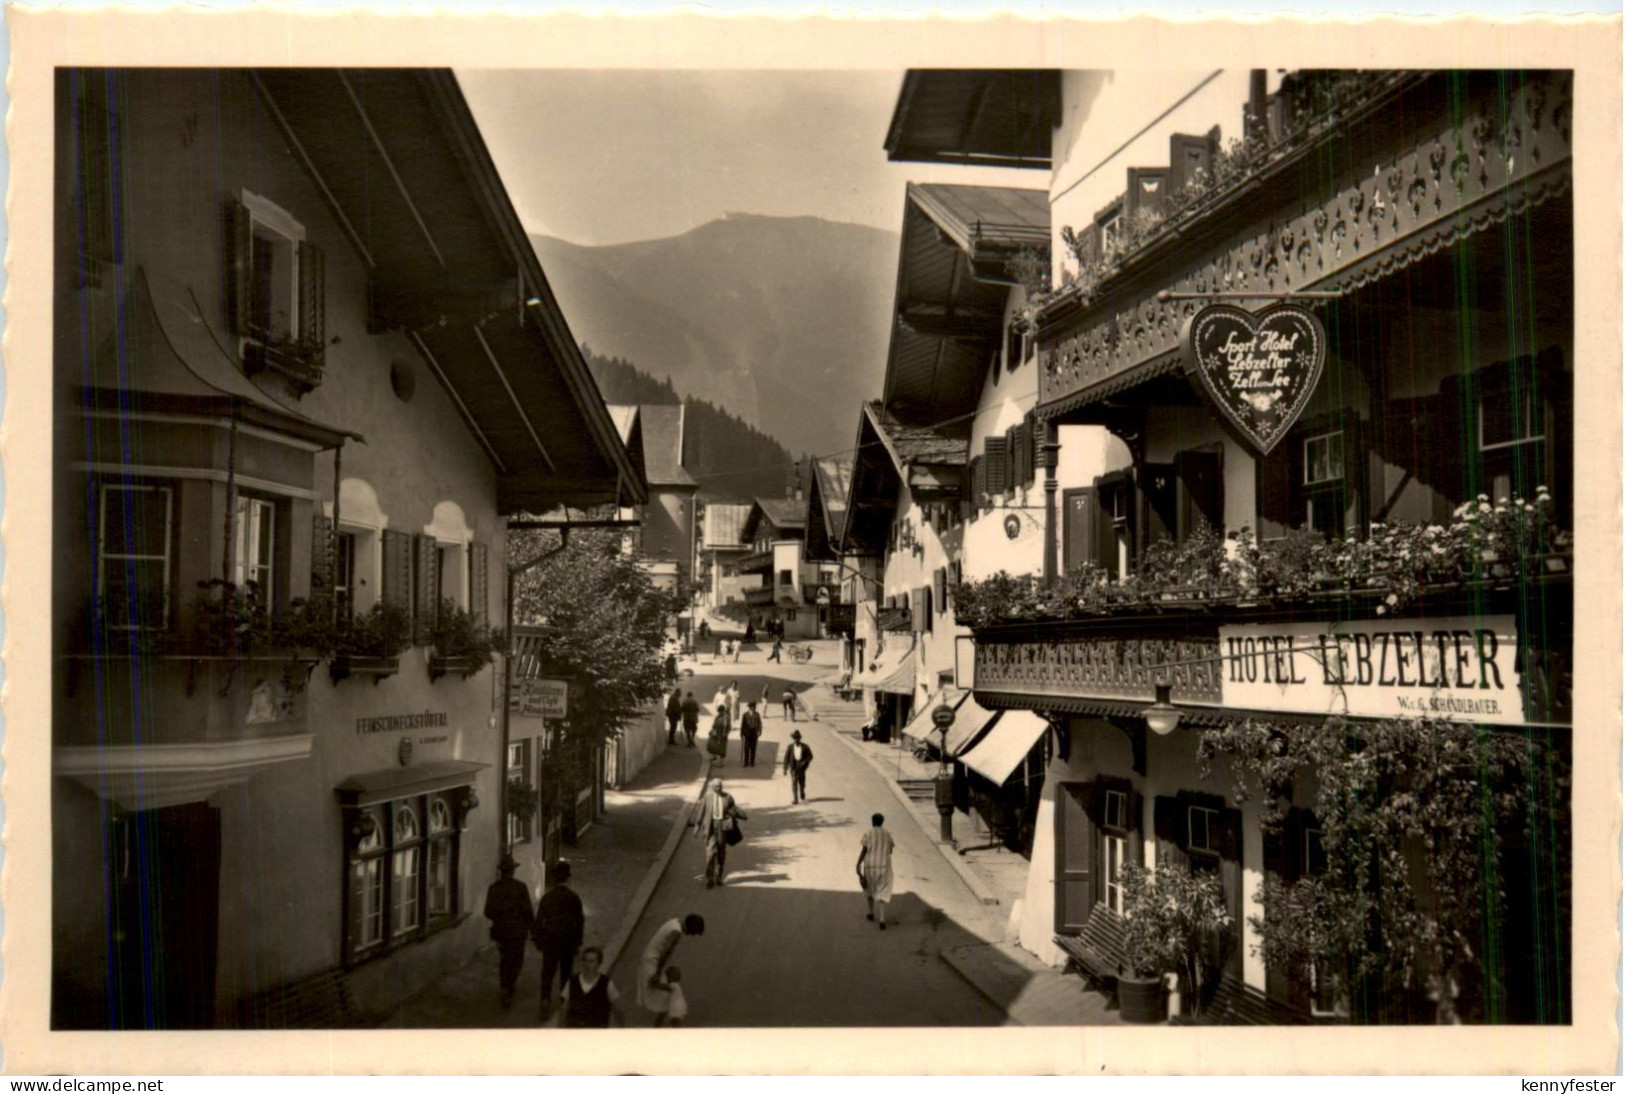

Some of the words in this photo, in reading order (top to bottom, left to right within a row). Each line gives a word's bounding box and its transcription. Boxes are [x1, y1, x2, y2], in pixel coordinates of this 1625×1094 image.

[1218, 331, 1257, 353] Sport
[1260, 330, 1299, 351] Hotel
[1227, 352, 1292, 371] Lebzelter
[1229, 371, 1262, 389] Zell
[1226, 636, 1306, 685] HOTEL
[1318, 629, 1504, 689] LEBZELTER
